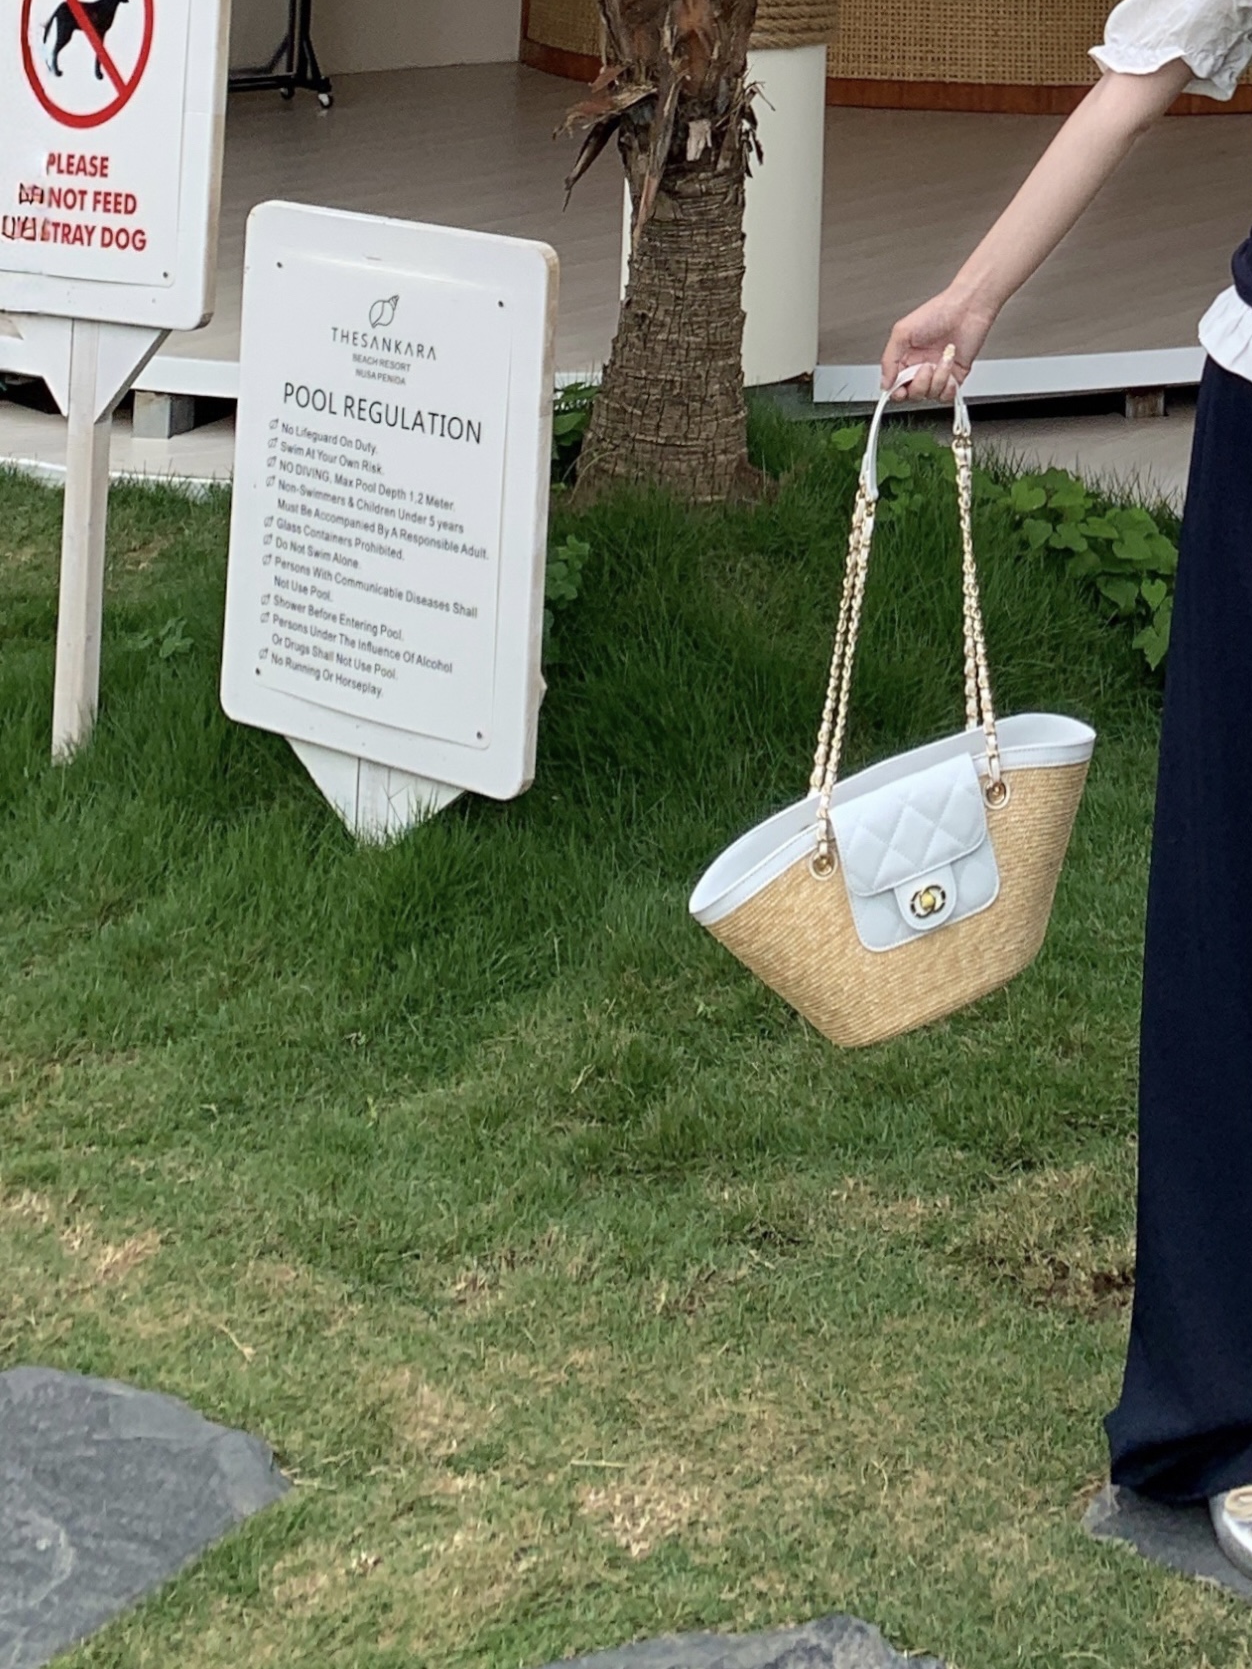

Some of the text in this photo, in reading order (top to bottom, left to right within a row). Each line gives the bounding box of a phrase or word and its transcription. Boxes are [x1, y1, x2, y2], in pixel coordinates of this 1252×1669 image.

[46, 152, 109, 178] PLEASE
[48, 187, 87, 211] NOT
[93, 190, 137, 215] FEED
[100, 227, 147, 252] DOG
[352, 353, 411, 372] BEACH RESORT
[355, 368, 376, 380] NUSA
[284, 382, 482, 444] POOL REGULATION
[281, 423, 294, 435] No
[296, 426, 338, 445] Lifeguard
[339, 435, 353, 448] On
[280, 441, 304, 455] Swim
[305, 448, 315, 460] At
[317, 450, 337, 464] Your
[339, 455, 360, 469] Own
[279, 460, 294, 473] NO
[334, 474, 354, 488] Max
[356, 478, 377, 492] Pool
[378, 484, 406, 500] Depth
[278, 479, 464, 534] Non-Swimmers & Children Under 5 years
[276, 518, 404, 560] Glass Containers Prohibited.
[277, 498, 299, 513] Must
[301, 504, 312, 518] Be
[314, 509, 375, 533] Accompanied
[377, 523, 389, 539] By
[391, 527, 398, 538] A
[400, 529, 460, 554] Responsible
[275, 536, 288, 550] Do
[290, 541, 305, 555] Not
[307, 546, 331, 561] Swim
[274, 575, 289, 589] Not
[291, 579, 308, 595] Use
[275, 556, 478, 618] Persons With Communicable Diseases Shall
[273, 594, 306, 612] Shower
[308, 604, 337, 623] Before
[339, 613, 378, 636] Entering
[272, 633, 282, 645] Or
[284, 637, 310, 656] Drugs
[336, 653, 352, 668] Not
[354, 659, 372, 672] Use
[273, 614, 453, 674] Persons Under The Influence Of Alcohol
[271, 653, 283, 666] No
[285, 657, 320, 681] Running
[322, 669, 333, 682] Or
